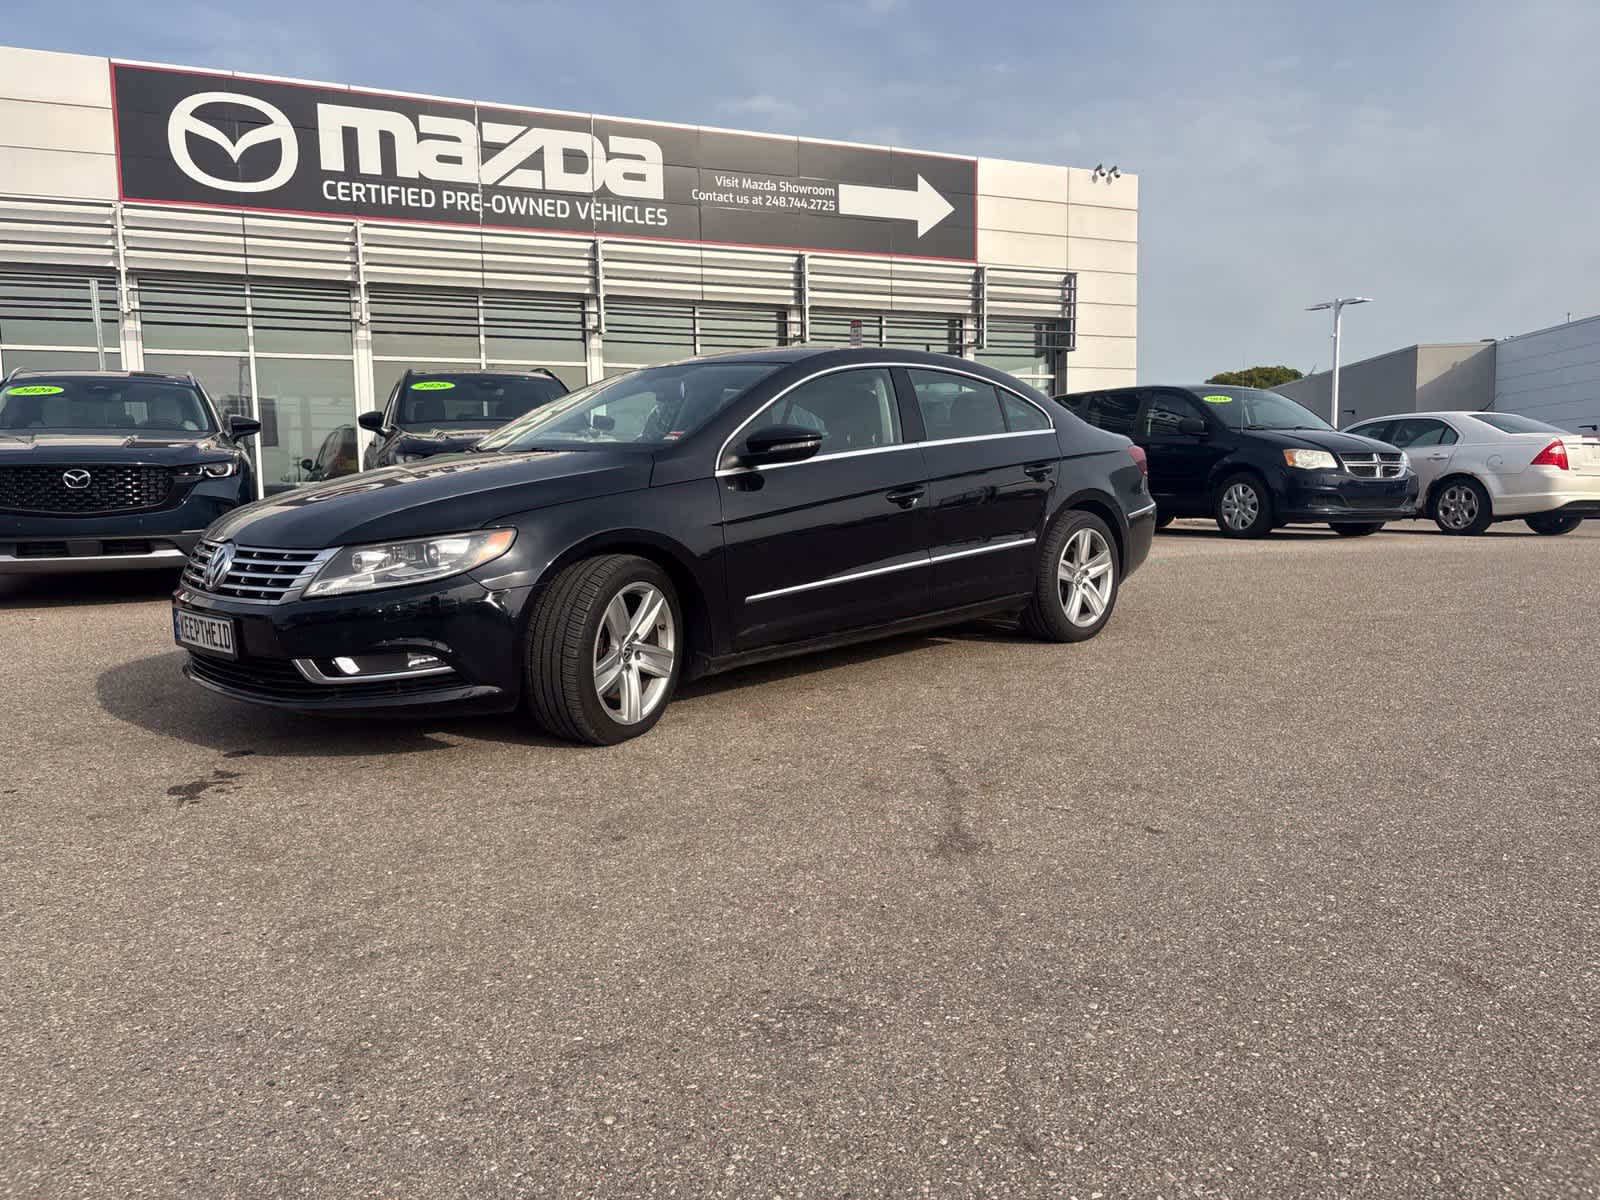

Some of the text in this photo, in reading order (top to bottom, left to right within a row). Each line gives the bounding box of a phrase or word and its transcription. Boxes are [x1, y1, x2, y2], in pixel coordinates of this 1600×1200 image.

[714, 175, 835, 197] Visit Mazda Showroom
[322, 180, 668, 226] CERTIFIED PRE-OWNED VEHICLES
[692, 188, 836, 211] Contact us at 248.744.2725
